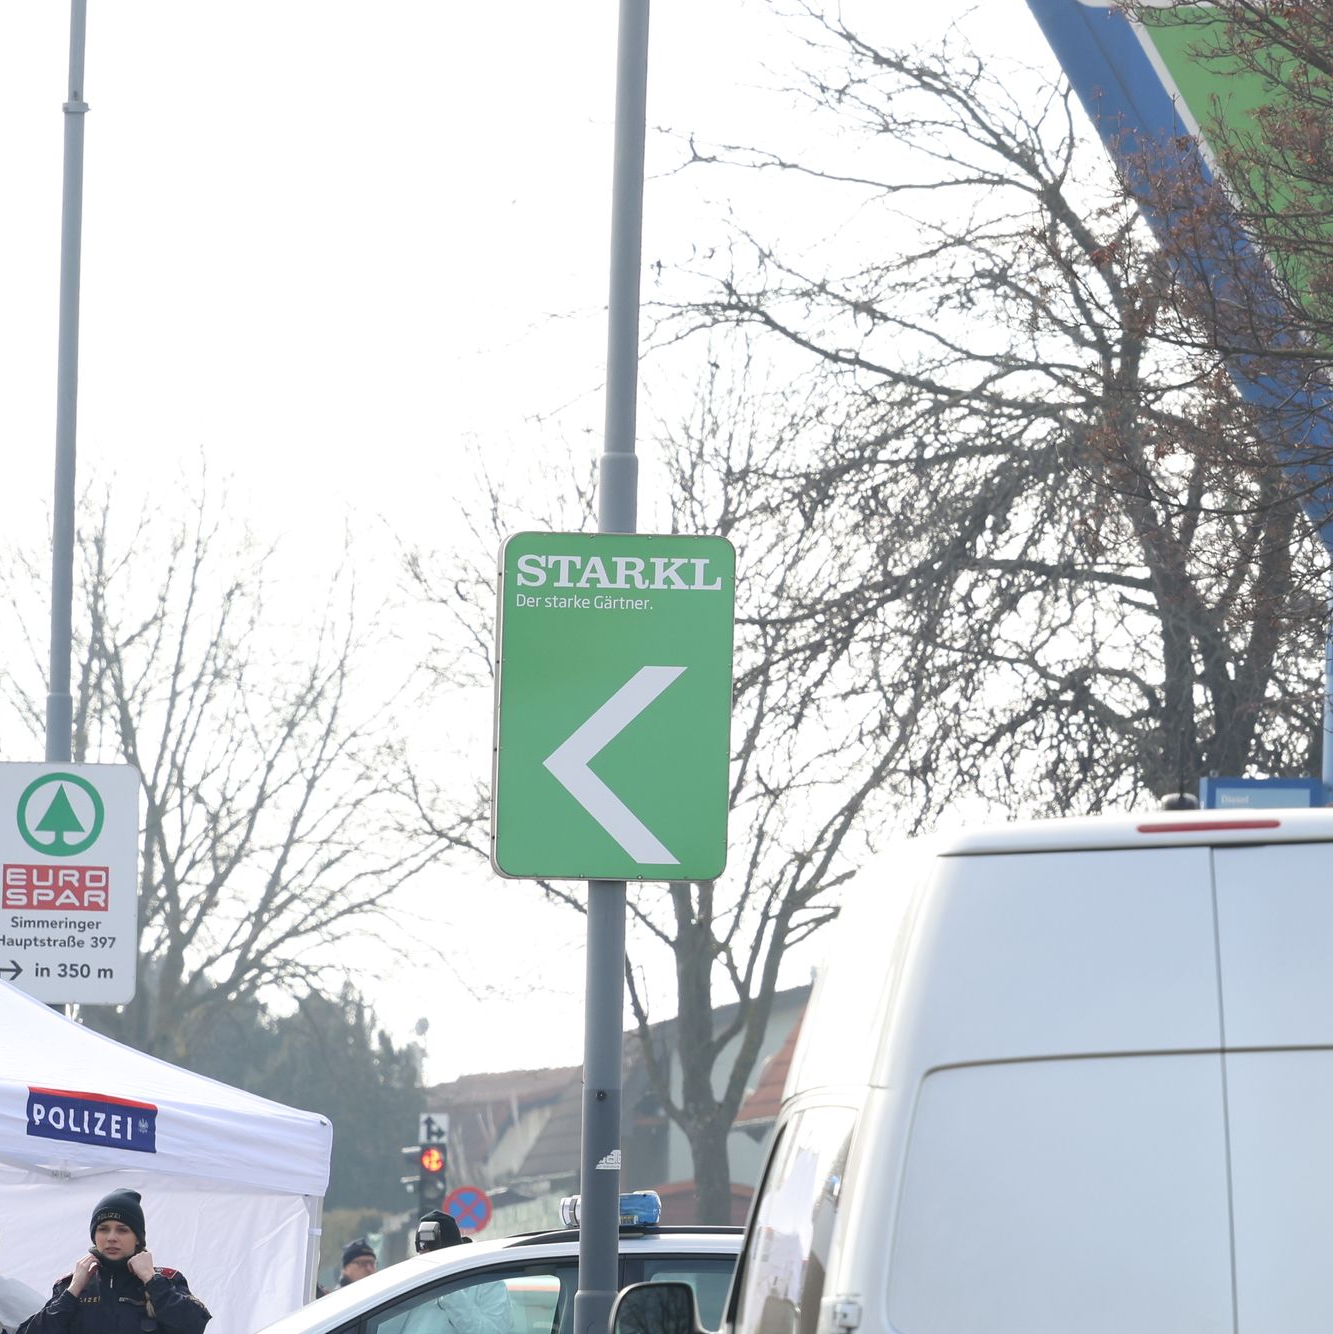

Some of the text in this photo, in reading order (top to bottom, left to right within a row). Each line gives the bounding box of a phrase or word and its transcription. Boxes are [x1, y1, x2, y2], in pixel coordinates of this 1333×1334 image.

[516, 554, 722, 590] STARKL
[516, 593, 653, 610] Der starke Gärtner.
[5, 868, 107, 887] EURO
[5, 888, 106, 907] SPAR
[11, 916, 101, 932] Simmeringer
[90, 936, 116, 949] 397
[35, 962, 113, 979] in 350 m
[33, 1103, 132, 1140] POLIZEI
